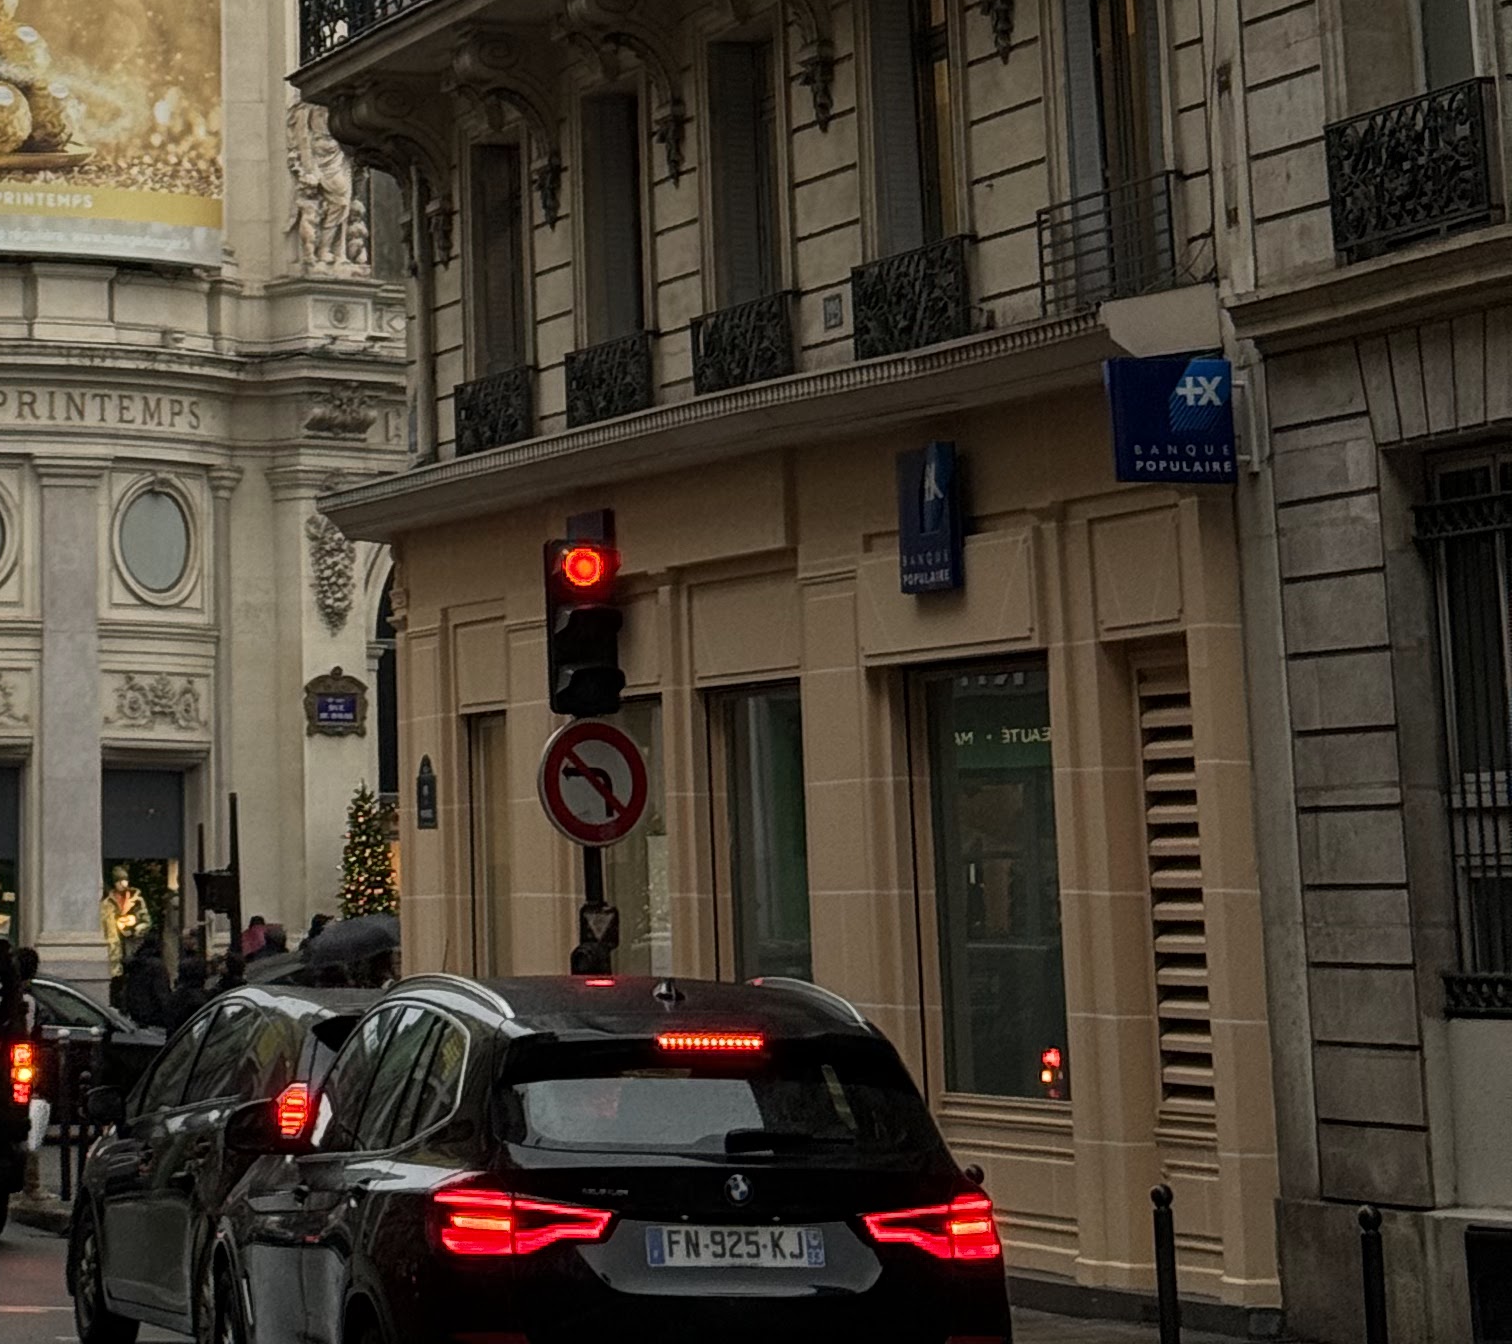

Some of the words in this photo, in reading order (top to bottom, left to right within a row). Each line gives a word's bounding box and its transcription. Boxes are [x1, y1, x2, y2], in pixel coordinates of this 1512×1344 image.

[1133, 444, 1232, 456] BANQUE
[1135, 460, 1233, 473] POPULAIRE
[666, 1228, 805, 1260] FN-925-KJ
